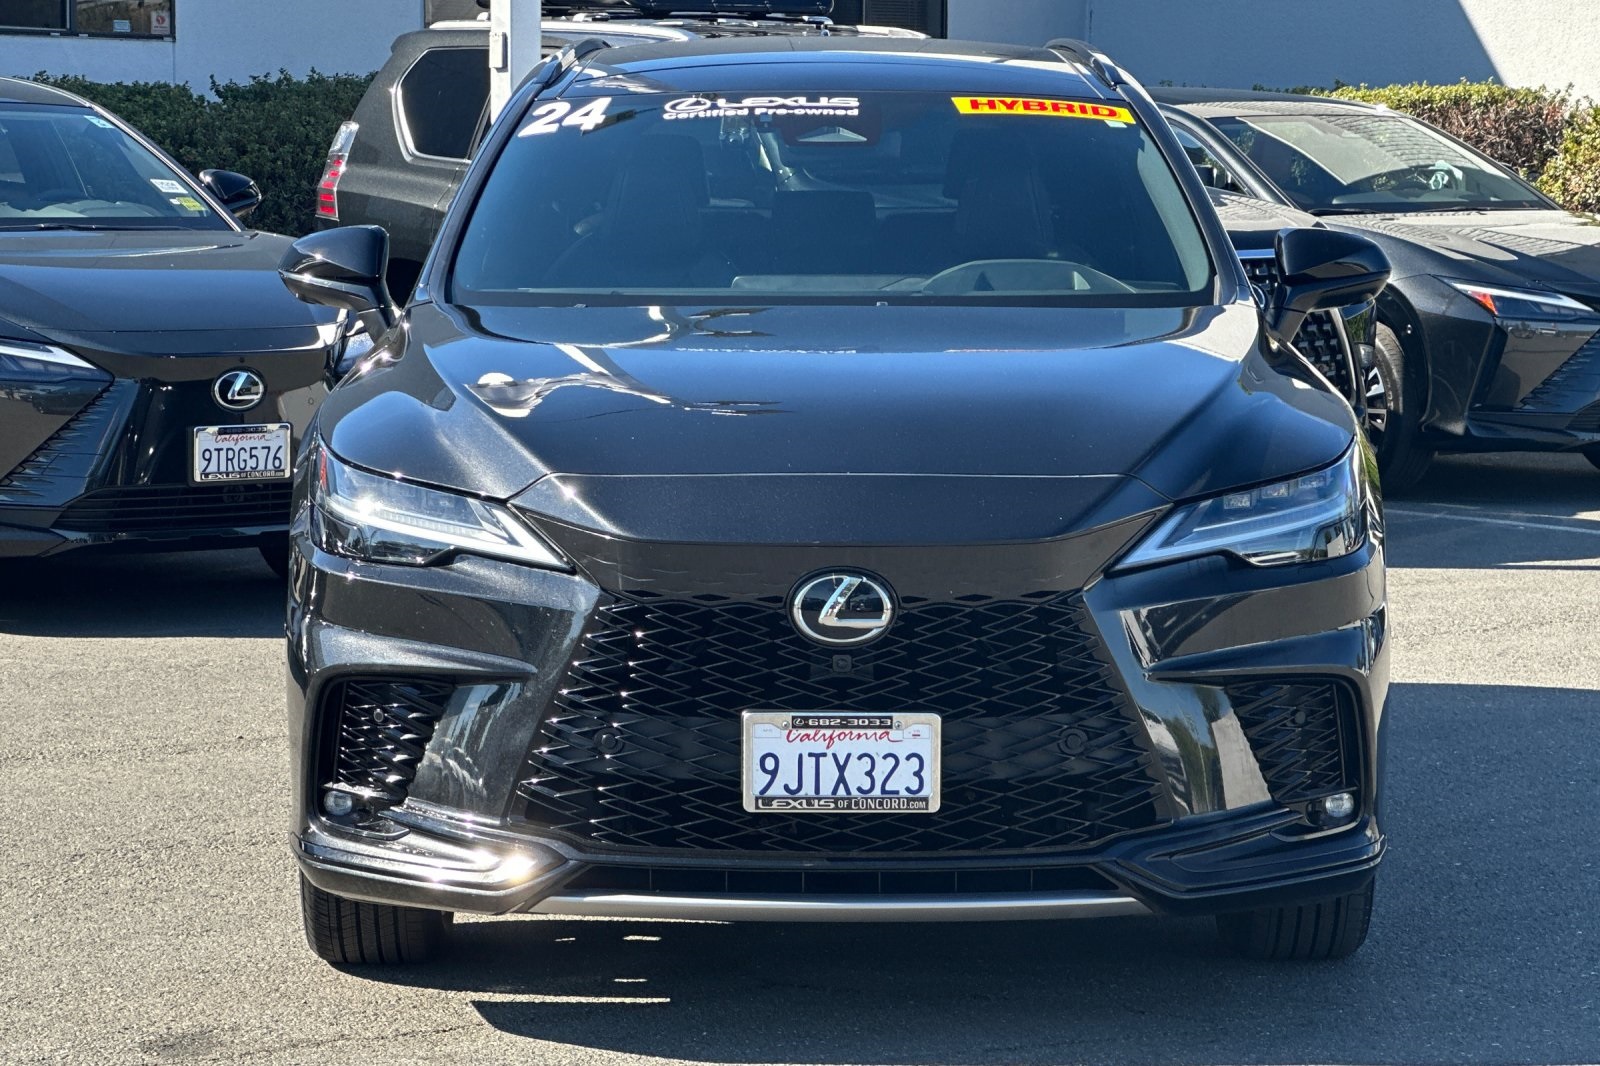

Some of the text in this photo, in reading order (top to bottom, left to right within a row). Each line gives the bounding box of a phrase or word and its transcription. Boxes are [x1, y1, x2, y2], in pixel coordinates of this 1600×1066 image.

[716, 97, 860, 107] LEXUS
[969, 98, 1119, 118] HYBRID
[518, 97, 612, 138] 24
[662, 108, 749, 120] Certified
[214, 433, 271, 446] California
[201, 445, 283, 473] 9TRG576
[201, 472, 240, 480] LEXUS
[807, 718, 892, 726] 682-3033
[786, 729, 903, 750] California
[758, 752, 925, 796] 9JTX323
[757, 798, 836, 809] LEXUS
[837, 799, 849, 809] OF
